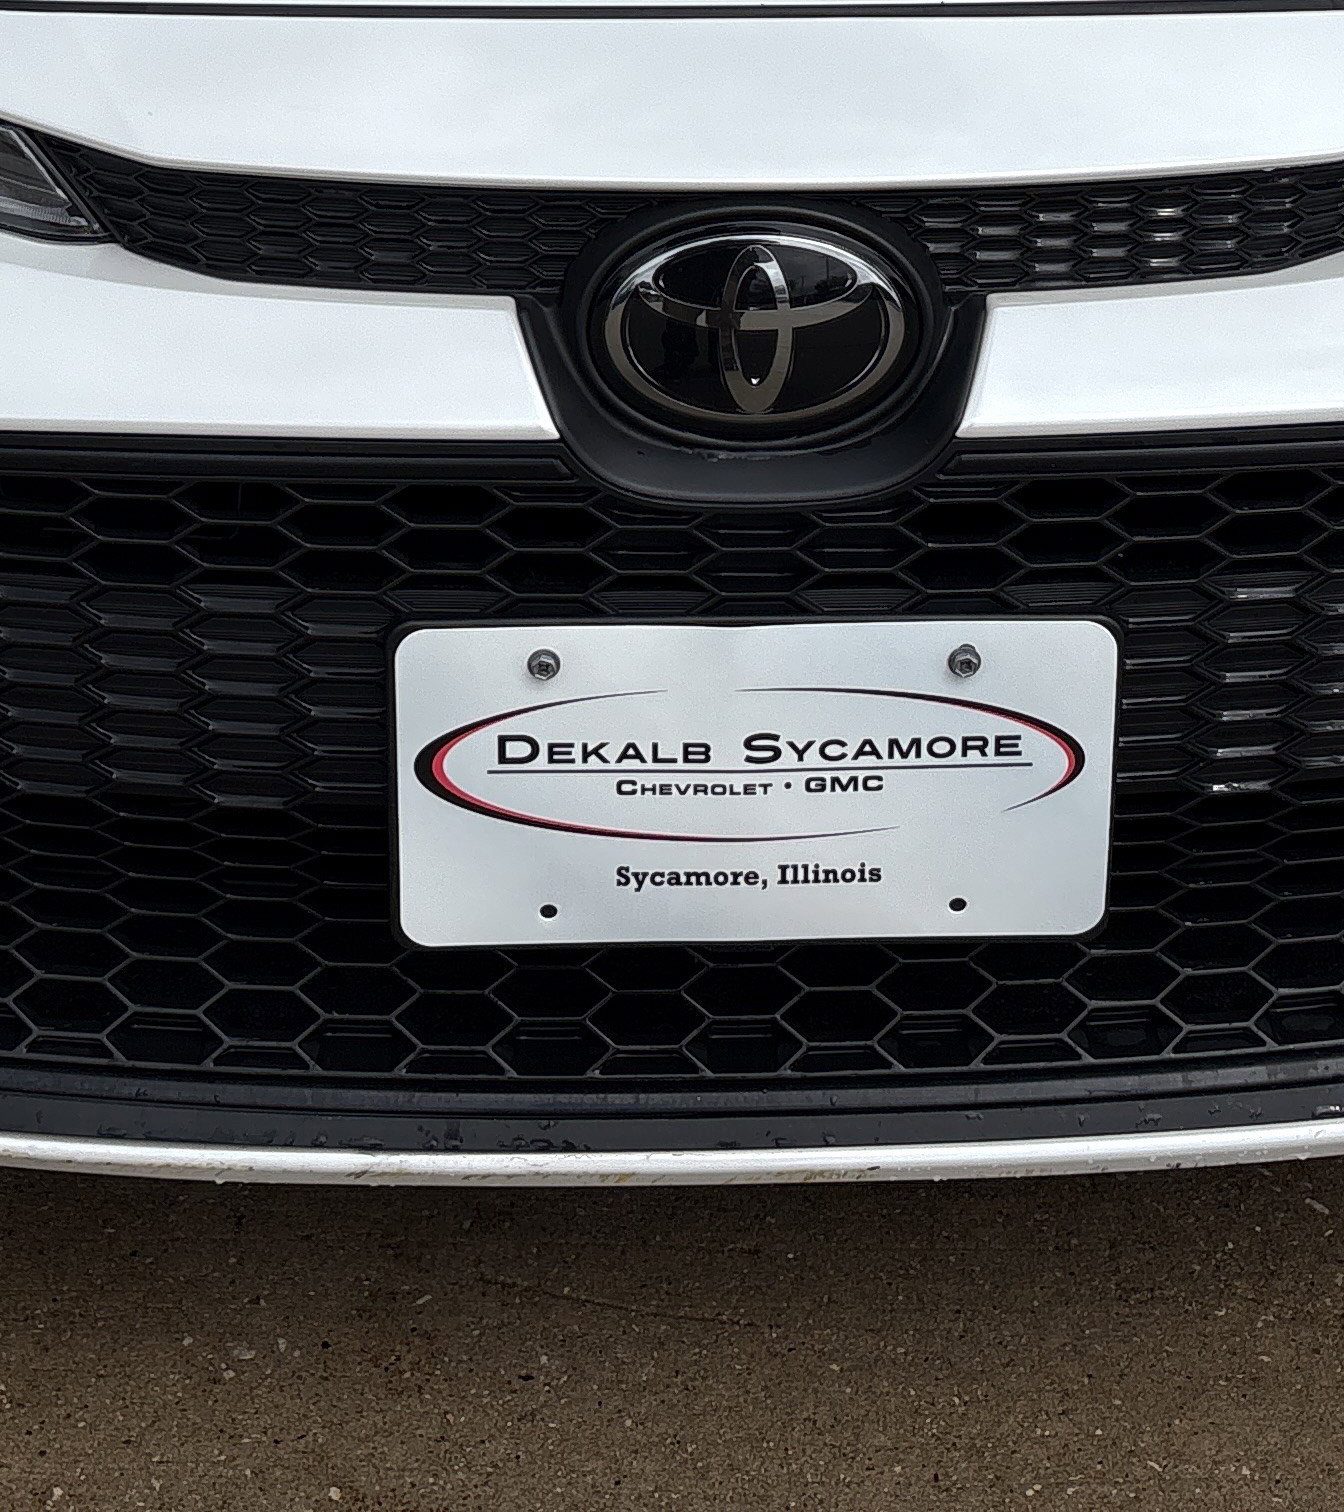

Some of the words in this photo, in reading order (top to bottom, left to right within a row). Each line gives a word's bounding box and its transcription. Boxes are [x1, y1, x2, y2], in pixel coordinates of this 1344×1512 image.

[497, 734, 712, 765] DEKALB
[743, 732, 1023, 765] SYCAMORE
[616, 779, 774, 796] CHEVROLET
[805, 775, 884, 793] GMC
[616, 866, 769, 893] Sycamore,
[777, 862, 882, 885] Illinois
